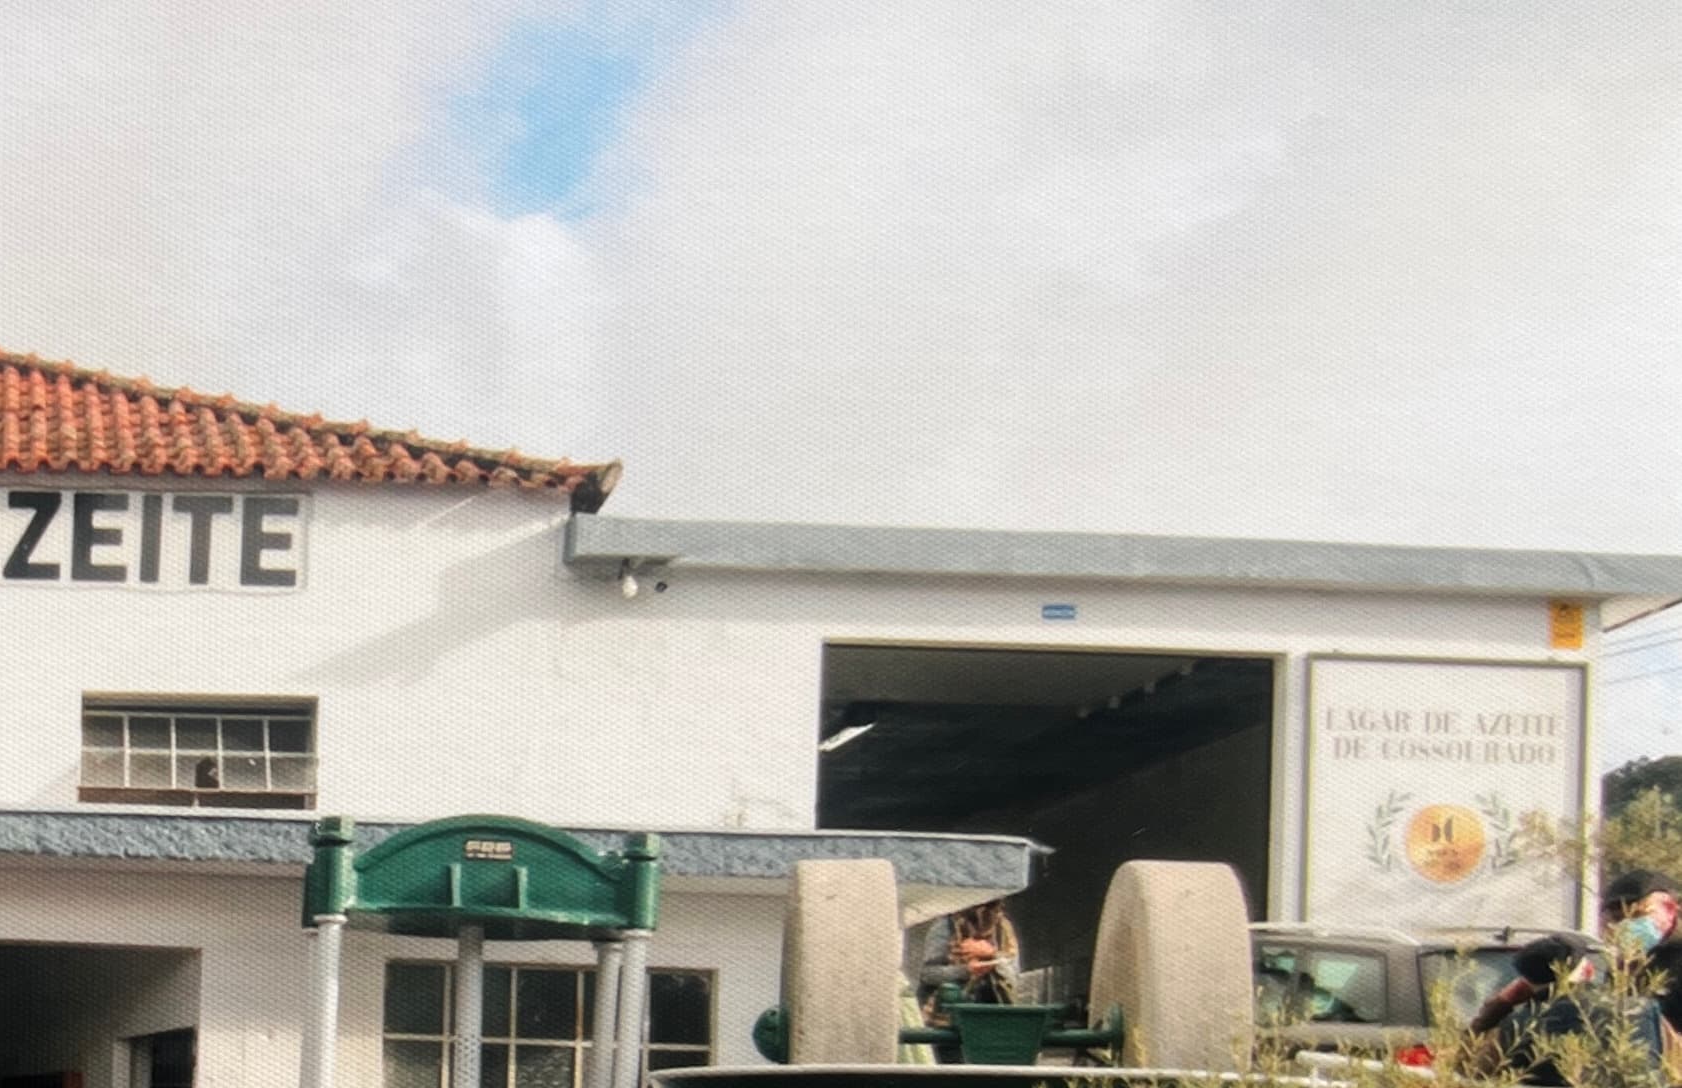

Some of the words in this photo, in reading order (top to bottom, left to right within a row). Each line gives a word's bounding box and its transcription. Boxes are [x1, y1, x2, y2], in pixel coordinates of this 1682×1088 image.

[1324, 707, 1411, 732] LAGAR
[1424, 710, 1458, 734] DE
[1475, 711, 1558, 737] AZEITE
[1332, 736, 1368, 760] DE
